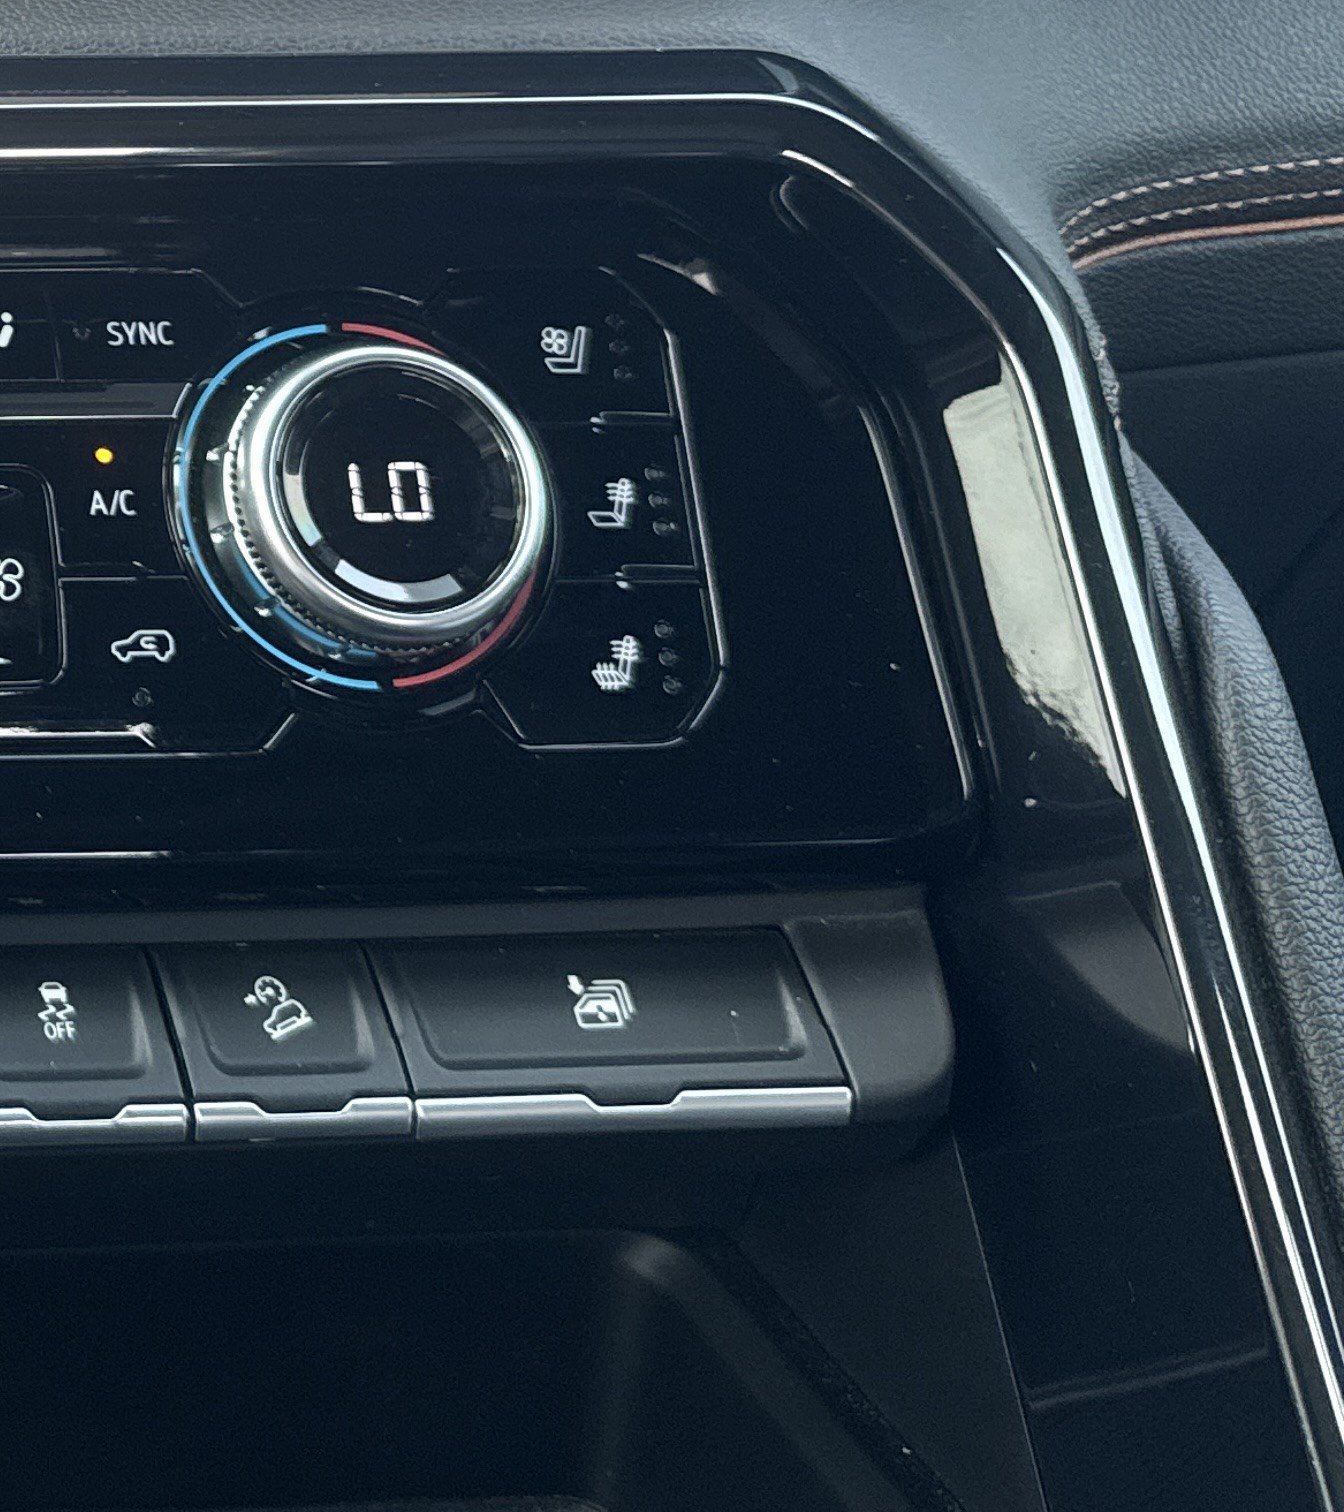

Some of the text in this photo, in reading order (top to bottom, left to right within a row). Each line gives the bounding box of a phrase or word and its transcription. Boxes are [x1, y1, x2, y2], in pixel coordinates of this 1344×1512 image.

[106, 320, 174, 347] SYNC
[89, 490, 136, 516] A/C
[43, 1020, 77, 1042] OFF
